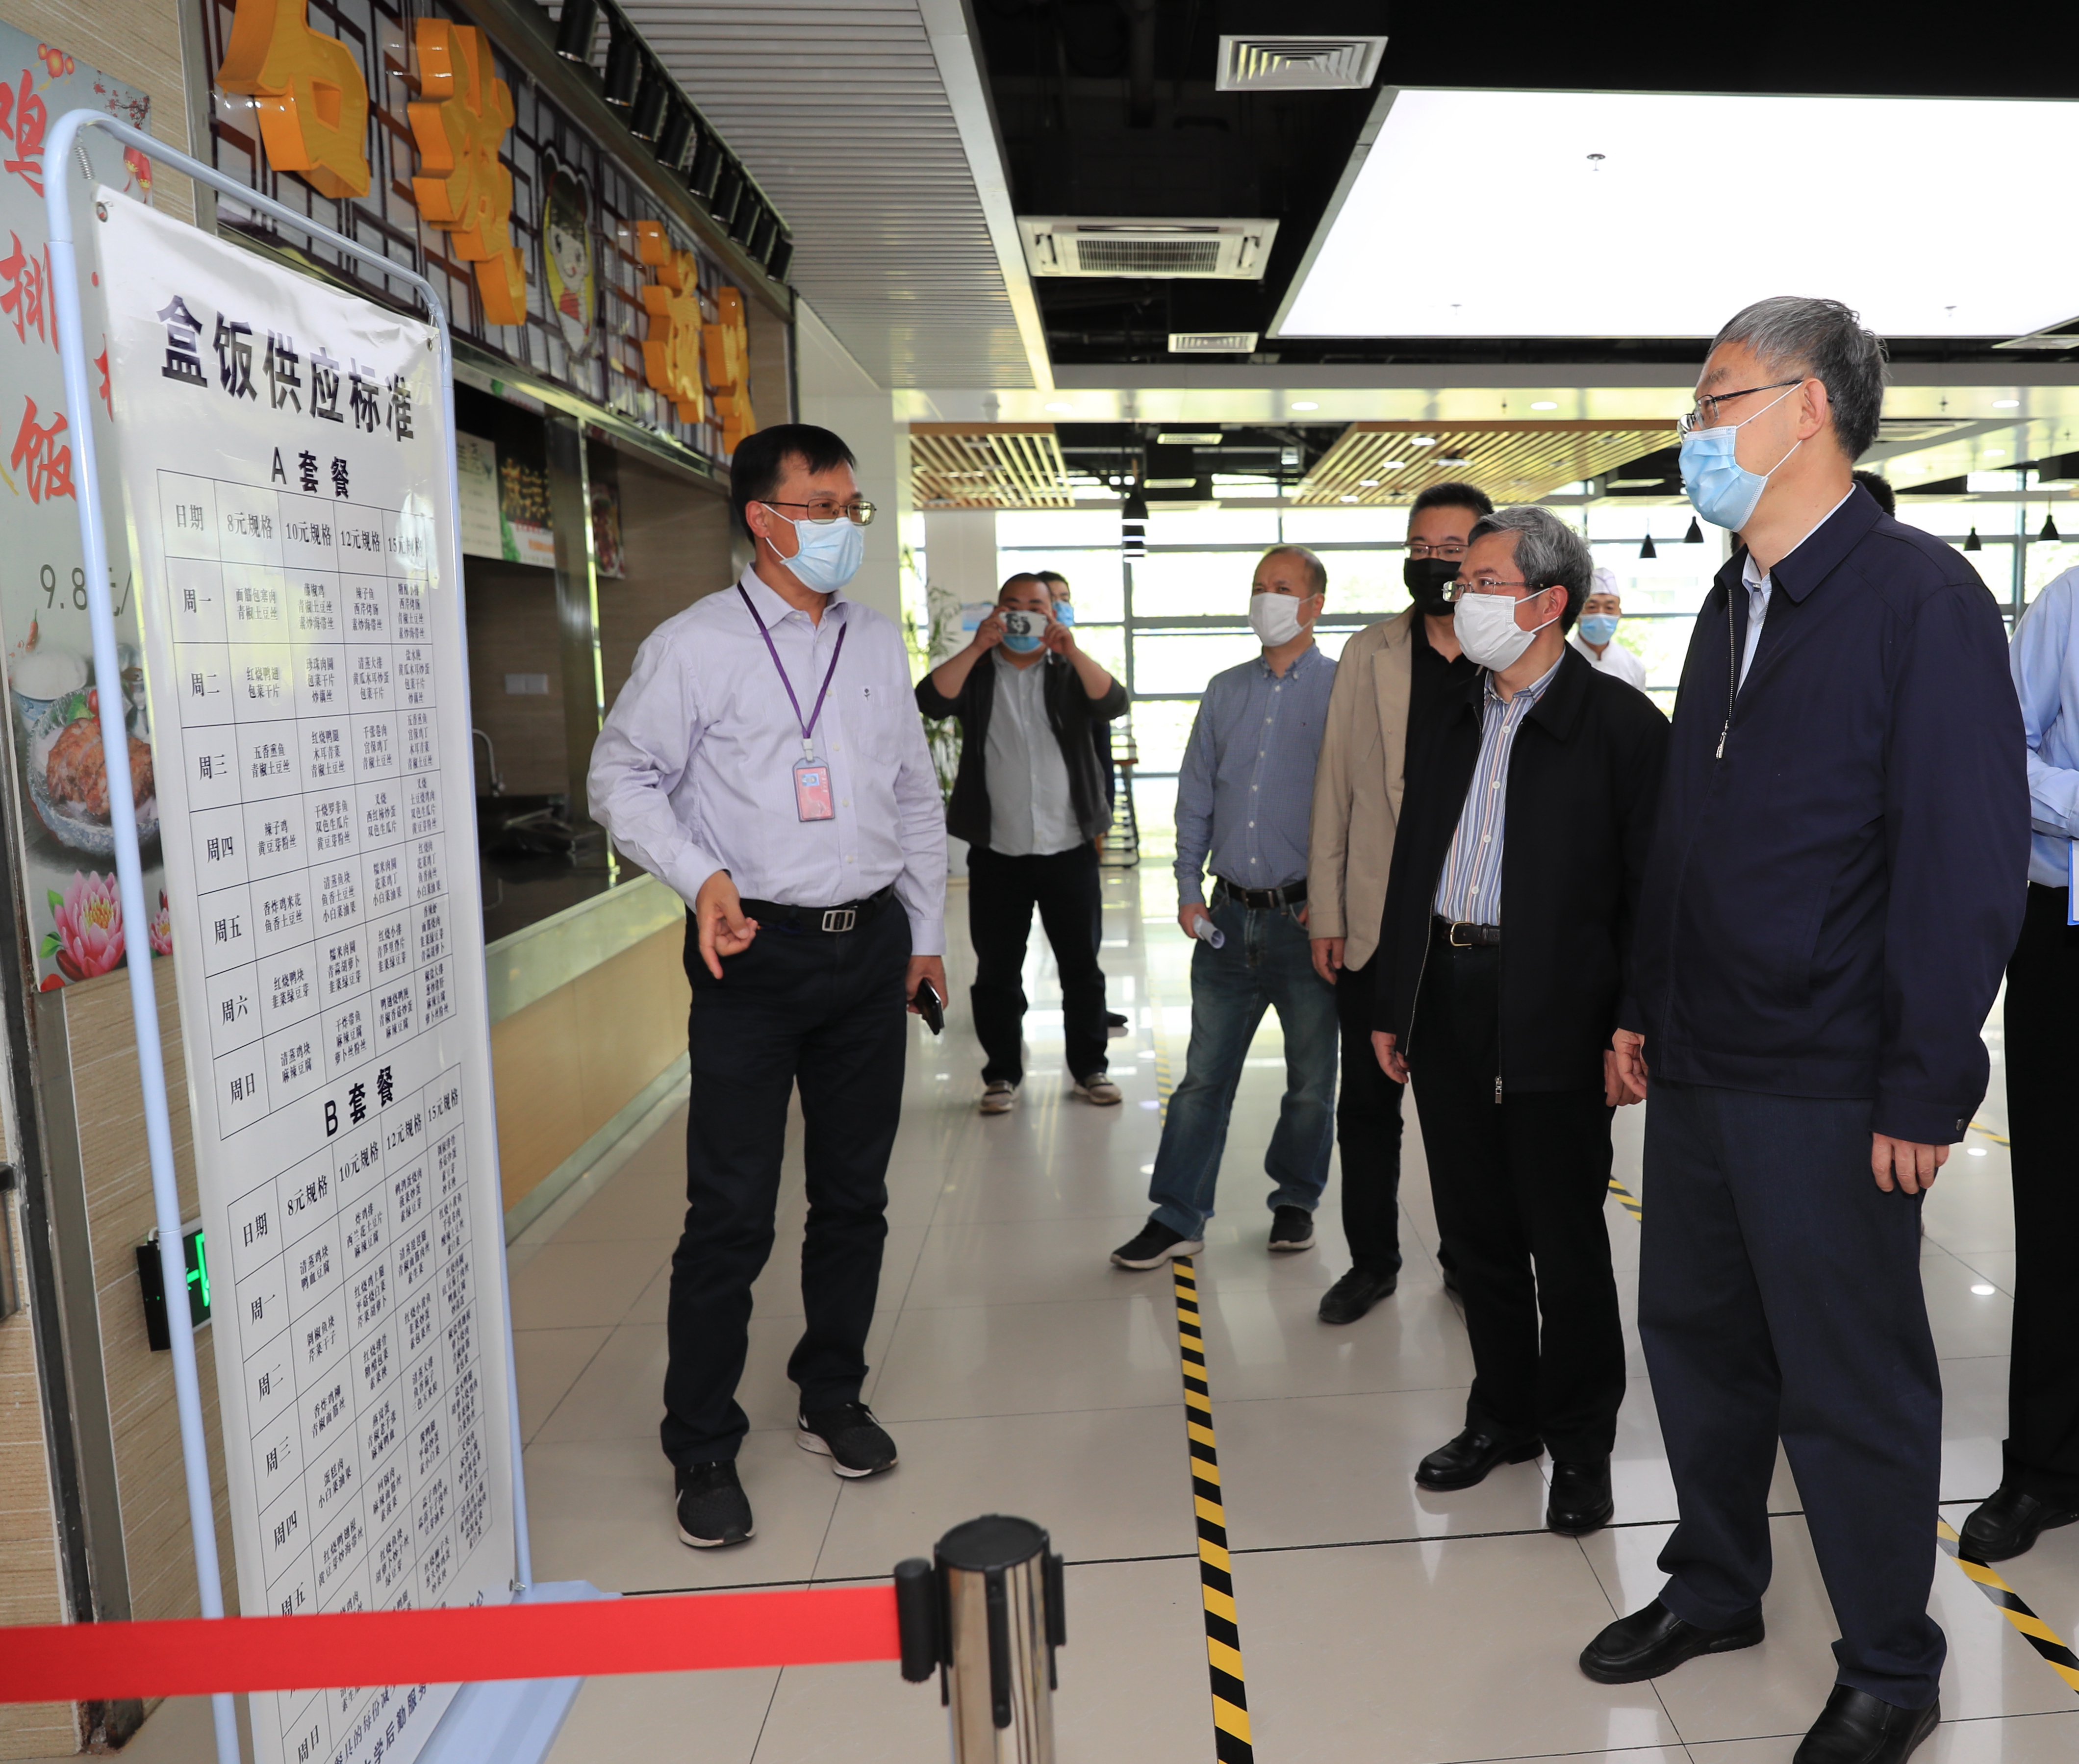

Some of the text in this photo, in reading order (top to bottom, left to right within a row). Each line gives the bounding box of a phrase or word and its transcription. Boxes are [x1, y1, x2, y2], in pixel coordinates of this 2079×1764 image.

[156, 294, 414, 442] 盒饭供应标准
[175, 504, 203, 531] 日期
[227, 511, 273, 539] 8元规格
[285, 521, 331, 546] 10元规格
[340, 529, 380, 552] 12元规格
[183, 588, 211, 613] 周一
[235, 587, 276, 604] 面筋包塞肉
[304, 582, 325, 598] 藤椒鸡
[355, 586, 374, 600] 辣子鱼
[236, 604, 278, 620] 青椒土豆丝
[298, 599, 333, 613] 青椒土豆丝
[354, 602, 378, 616] 西芹烤肠
[300, 615, 334, 630] 素炒海带丝
[352, 617, 382, 631] 素炒海带丝
[246, 666, 279, 681] 红烧鸭翅
[306, 657, 333, 671] 珍珠肉圆
[357, 656, 382, 670] 清蒸大排
[191, 673, 220, 697] 周二
[307, 673, 334, 687] 包菜干片
[353, 671, 389, 685] 黄瓜木耳炒蛋
[248, 683, 279, 699] 包菜干片
[311, 689, 333, 703] 炒藕丝
[360, 686, 384, 700] 包菜干片
[311, 729, 339, 744] 红烧鸭腿
[363, 724, 387, 739] 千张卷肉
[254, 742, 285, 759] 五香熏鱼
[313, 744, 340, 761] 木耳青菜
[363, 738, 388, 755] 宫保鸡丁
[199, 754, 227, 780] 周三
[251, 759, 290, 778] 青椒土豆丝
[311, 760, 345, 778] 青椒土豆丝
[363, 753, 392, 770] 青椒土豆丝
[314, 800, 348, 818] 干烧罗非鱼
[375, 792, 386, 805] 叉烧
[315, 814, 349, 833] 双色生瓜片
[366, 805, 396, 823] 西红柿炒蛋
[264, 819, 288, 836] 辣子鸡
[367, 820, 397, 837] 双色生瓜片
[206, 836, 233, 862] 周四
[257, 834, 297, 856] 黄豆芽粉丝
[317, 831, 351, 851] 黄豆芽粉丝
[373, 857, 397, 875] 糯米肉圆
[323, 870, 351, 890] 清蒸鱼块
[375, 872, 397, 890] 花菜鸡丁
[263, 892, 302, 916] 香炸鸡米花
[321, 885, 355, 907] 鱼香土豆丝
[373, 886, 402, 907] 小白菜油果
[264, 909, 303, 933] 鱼香土豆丝
[323, 900, 356, 923] 小白菜油果
[214, 914, 242, 944] 周五
[378, 923, 402, 942] 红烧小排
[329, 940, 355, 961] 糯米肉圆
[377, 936, 405, 959] 青笋里脊片
[328, 955, 359, 979] 青蒜胡萝卜
[378, 951, 406, 973] 韭菜绿豆芽
[273, 968, 304, 991] 红烧鸭块
[329, 970, 361, 994] 韭菜绿豆芽
[272, 983, 308, 1009] 韭菜绿豆芽
[222, 995, 248, 1025] 周六
[335, 1010, 361, 1033] 干炸带鱼
[379, 999, 412, 1027] 青椒香菇炒蛋
[336, 1024, 362, 1048] 麻辣豆腐
[385, 1017, 408, 1038] 麻辣豆腐
[280, 1041, 310, 1066] 清蒸鸡块
[334, 1038, 366, 1065] 萝卜丝粉丝
[281, 1057, 311, 1083] 麻辣豆腐
[230, 1072, 255, 1104] 周日
[428, 1087, 458, 1122] 15元规格
[386, 1112, 422, 1150] 12元规格
[339, 1141, 379, 1182] 10元规格
[287, 1174, 328, 1216] 8元规格
[243, 1212, 268, 1247] 日期
[299, 1244, 329, 1275] 清蒸鸡块
[301, 1259, 330, 1291] 鸭血豆腐
[251, 1294, 275, 1325] 周一
[306, 1315, 334, 1347] 剁椒鱼块
[308, 1330, 335, 1363] 芹菜干子
[258, 1363, 283, 1401] 周二
[312, 1396, 345, 1438] 青椒面筋丝
[266, 1436, 290, 1477] 周三
[318, 1465, 351, 1509] 小白菜油果
[274, 1510, 297, 1551] 周四
[323, 1517, 356, 1564] 红烧鸭翅根
[318, 1526, 363, 1588] 黄豆芽炒海带丝
[281, 1582, 305, 1617] 周五
[298, 1725, 319, 1764] 周日
